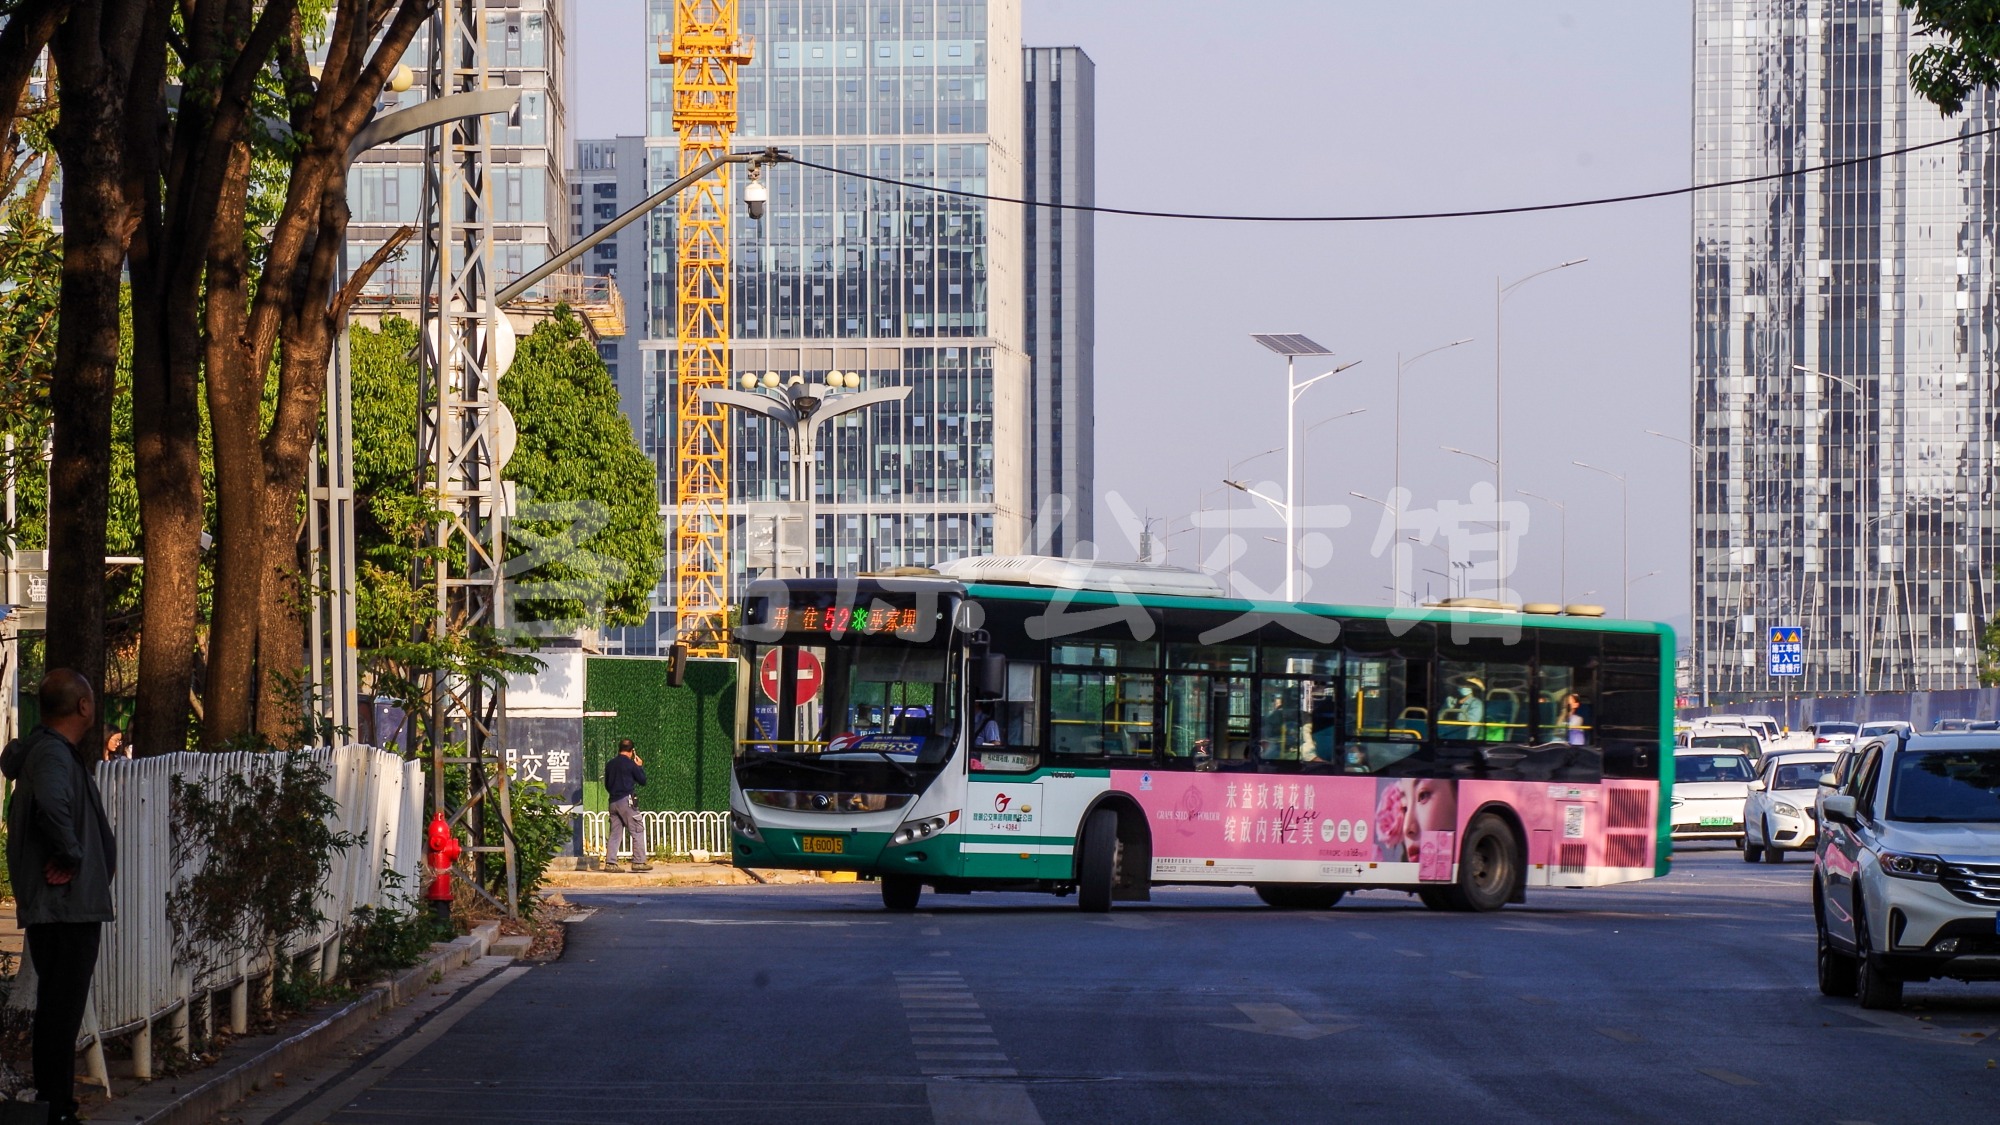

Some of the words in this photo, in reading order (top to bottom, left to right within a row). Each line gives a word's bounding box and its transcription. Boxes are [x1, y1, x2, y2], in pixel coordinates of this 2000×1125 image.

[824, 608, 849, 631] 52
[869, 608, 916, 632] 巫家坝
[1772, 643, 1800, 653] 施工车辆
[1772, 654, 1800, 663] 出入口
[1772, 663, 1800, 673] 减速慢行
[1224, 815, 1314, 844] 绽放内养之美
